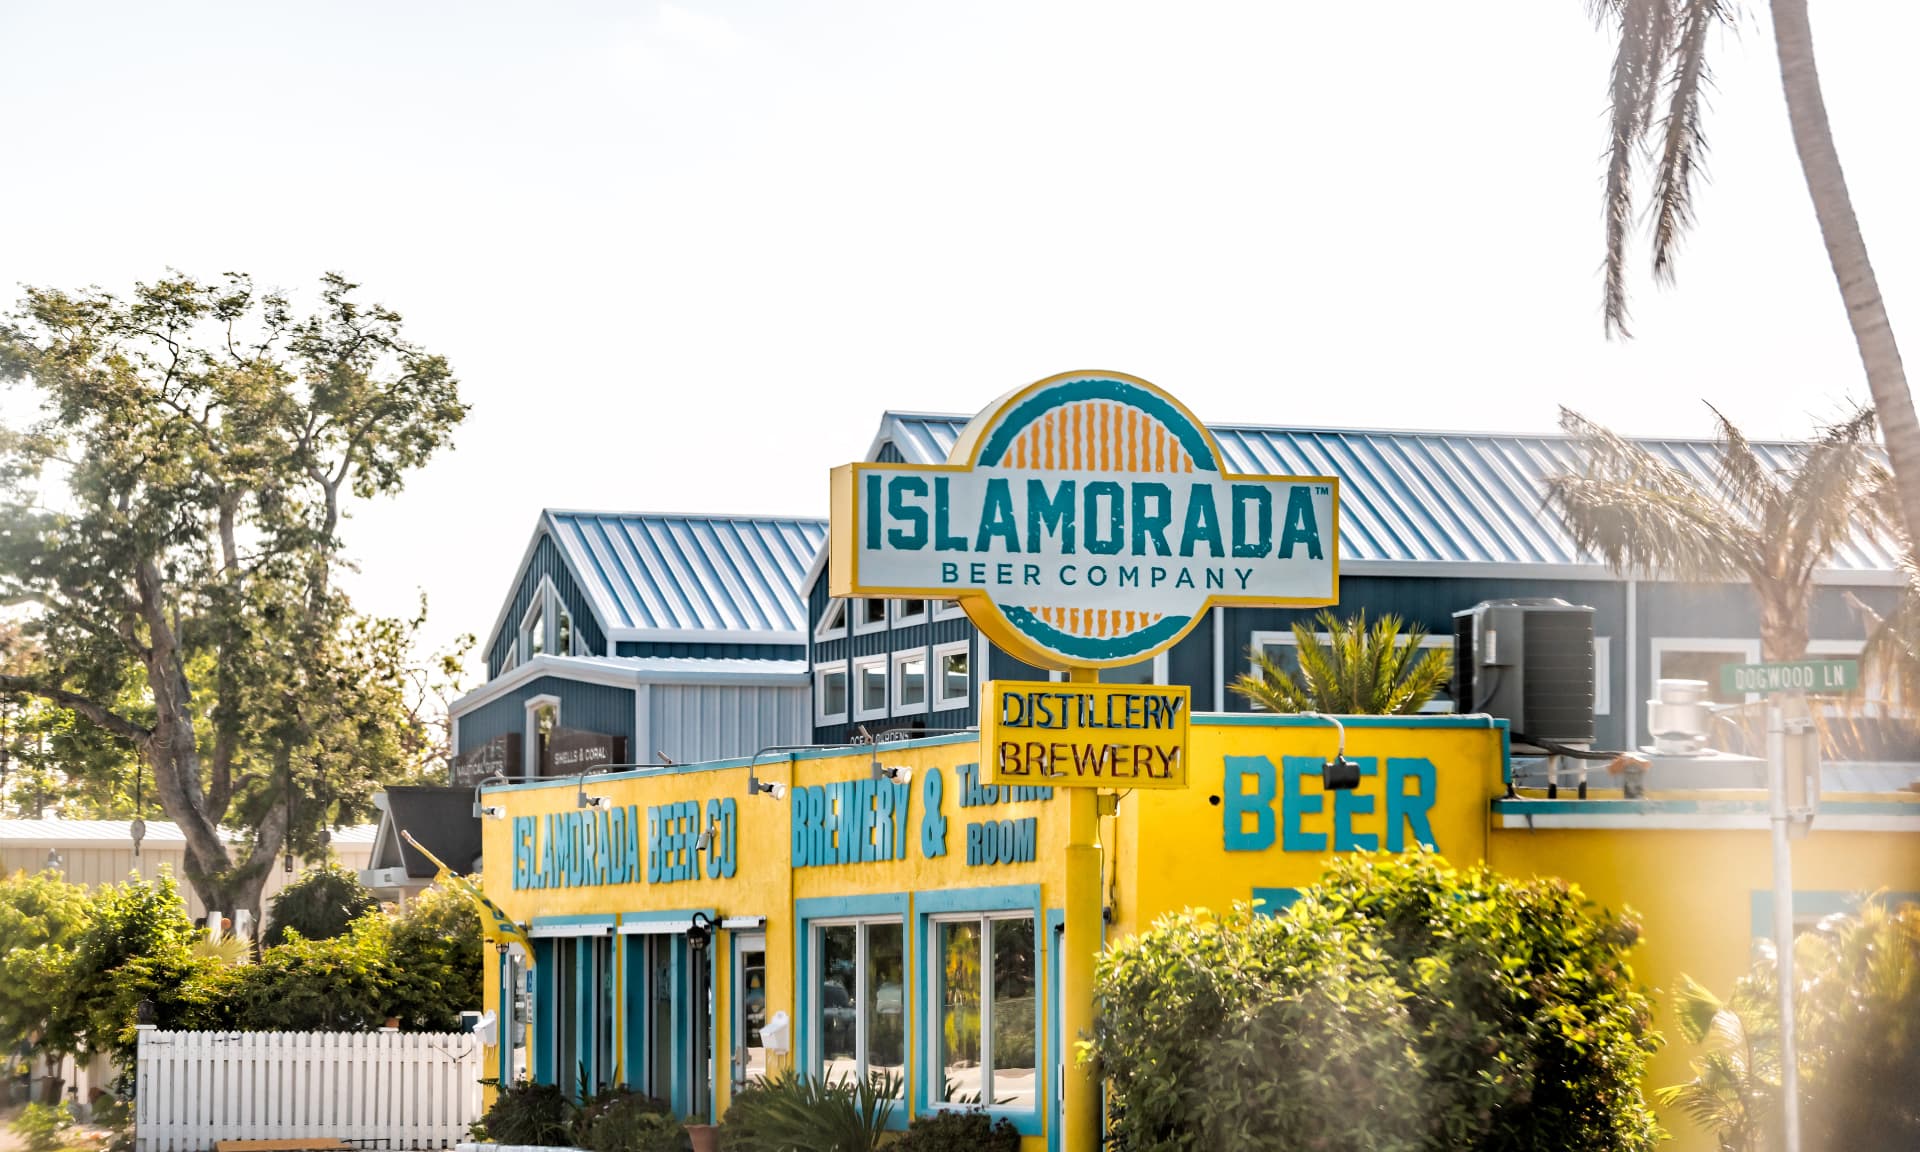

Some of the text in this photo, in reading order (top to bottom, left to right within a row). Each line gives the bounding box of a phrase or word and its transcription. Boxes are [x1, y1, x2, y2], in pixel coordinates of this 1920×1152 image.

[866, 474, 1324, 560] ISLAMORADA
[941, 562, 1253, 589] BEER COMPANY
[1735, 665, 1844, 690] DOGWOOD LN
[1003, 692, 1184, 729] DISTILLERY
[1000, 741, 1181, 779] BREWERY
[791, 777, 910, 868] BREWERY
[921, 768, 947, 859] &
[1224, 755, 1440, 853] BEER
[512, 797, 738, 891] ISLAMORADA BEER CO
[966, 816, 1038, 866] ROOM
